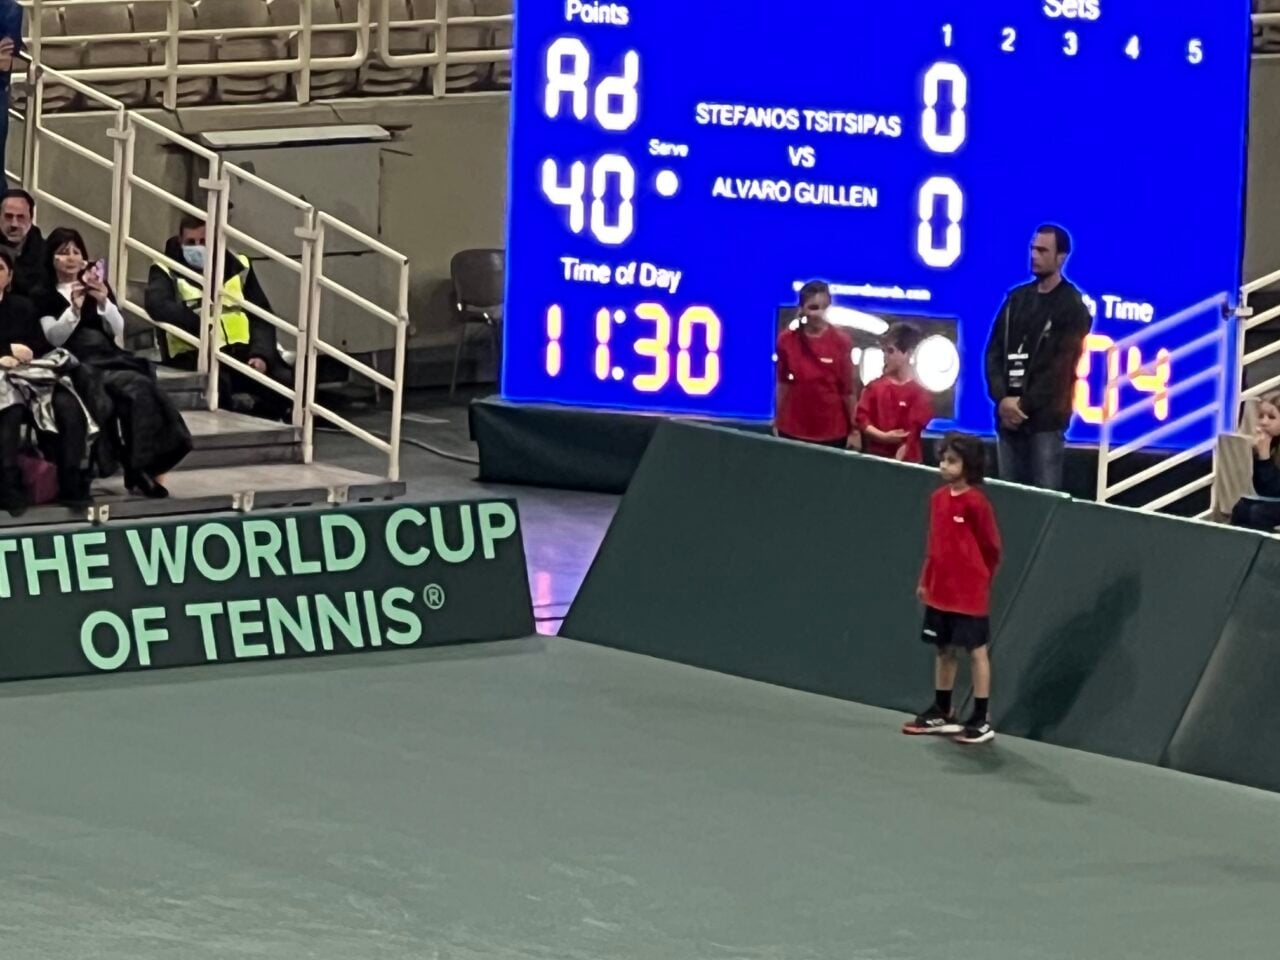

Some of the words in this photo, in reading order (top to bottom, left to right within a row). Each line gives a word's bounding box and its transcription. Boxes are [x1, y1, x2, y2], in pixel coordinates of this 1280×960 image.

[565, 0, 629, 25] Points
[1043, 0, 1100, 20] Sets
[942, 24, 952, 47] 1
[1001, 27, 1016, 52] 2
[1063, 30, 1078, 55] 3
[1125, 35, 1139, 59] 4
[1188, 39, 1203, 64] 5
[545, 37, 639, 130] Ad
[696, 103, 800, 130] STEFANOS
[803, 110, 902, 137] TSITSIPAS
[922, 61, 967, 152] 0
[788, 146, 816, 168] VS
[542, 153, 635, 244] 40
[712, 177, 791, 202] ALVARO
[794, 182, 878, 207] GUILLEN
[918, 176, 963, 267] 0
[560, 257, 611, 284] Time
[615, 262, 637, 285] of
[639, 262, 681, 294] Day
[1102, 295, 1154, 322] Time
[546, 302, 721, 395] 11:30
[0, 532, 114, 598] THE
[125, 514, 366, 586] WORLD
[384, 502, 517, 566] CUP
[80, 607, 169, 670] OF
